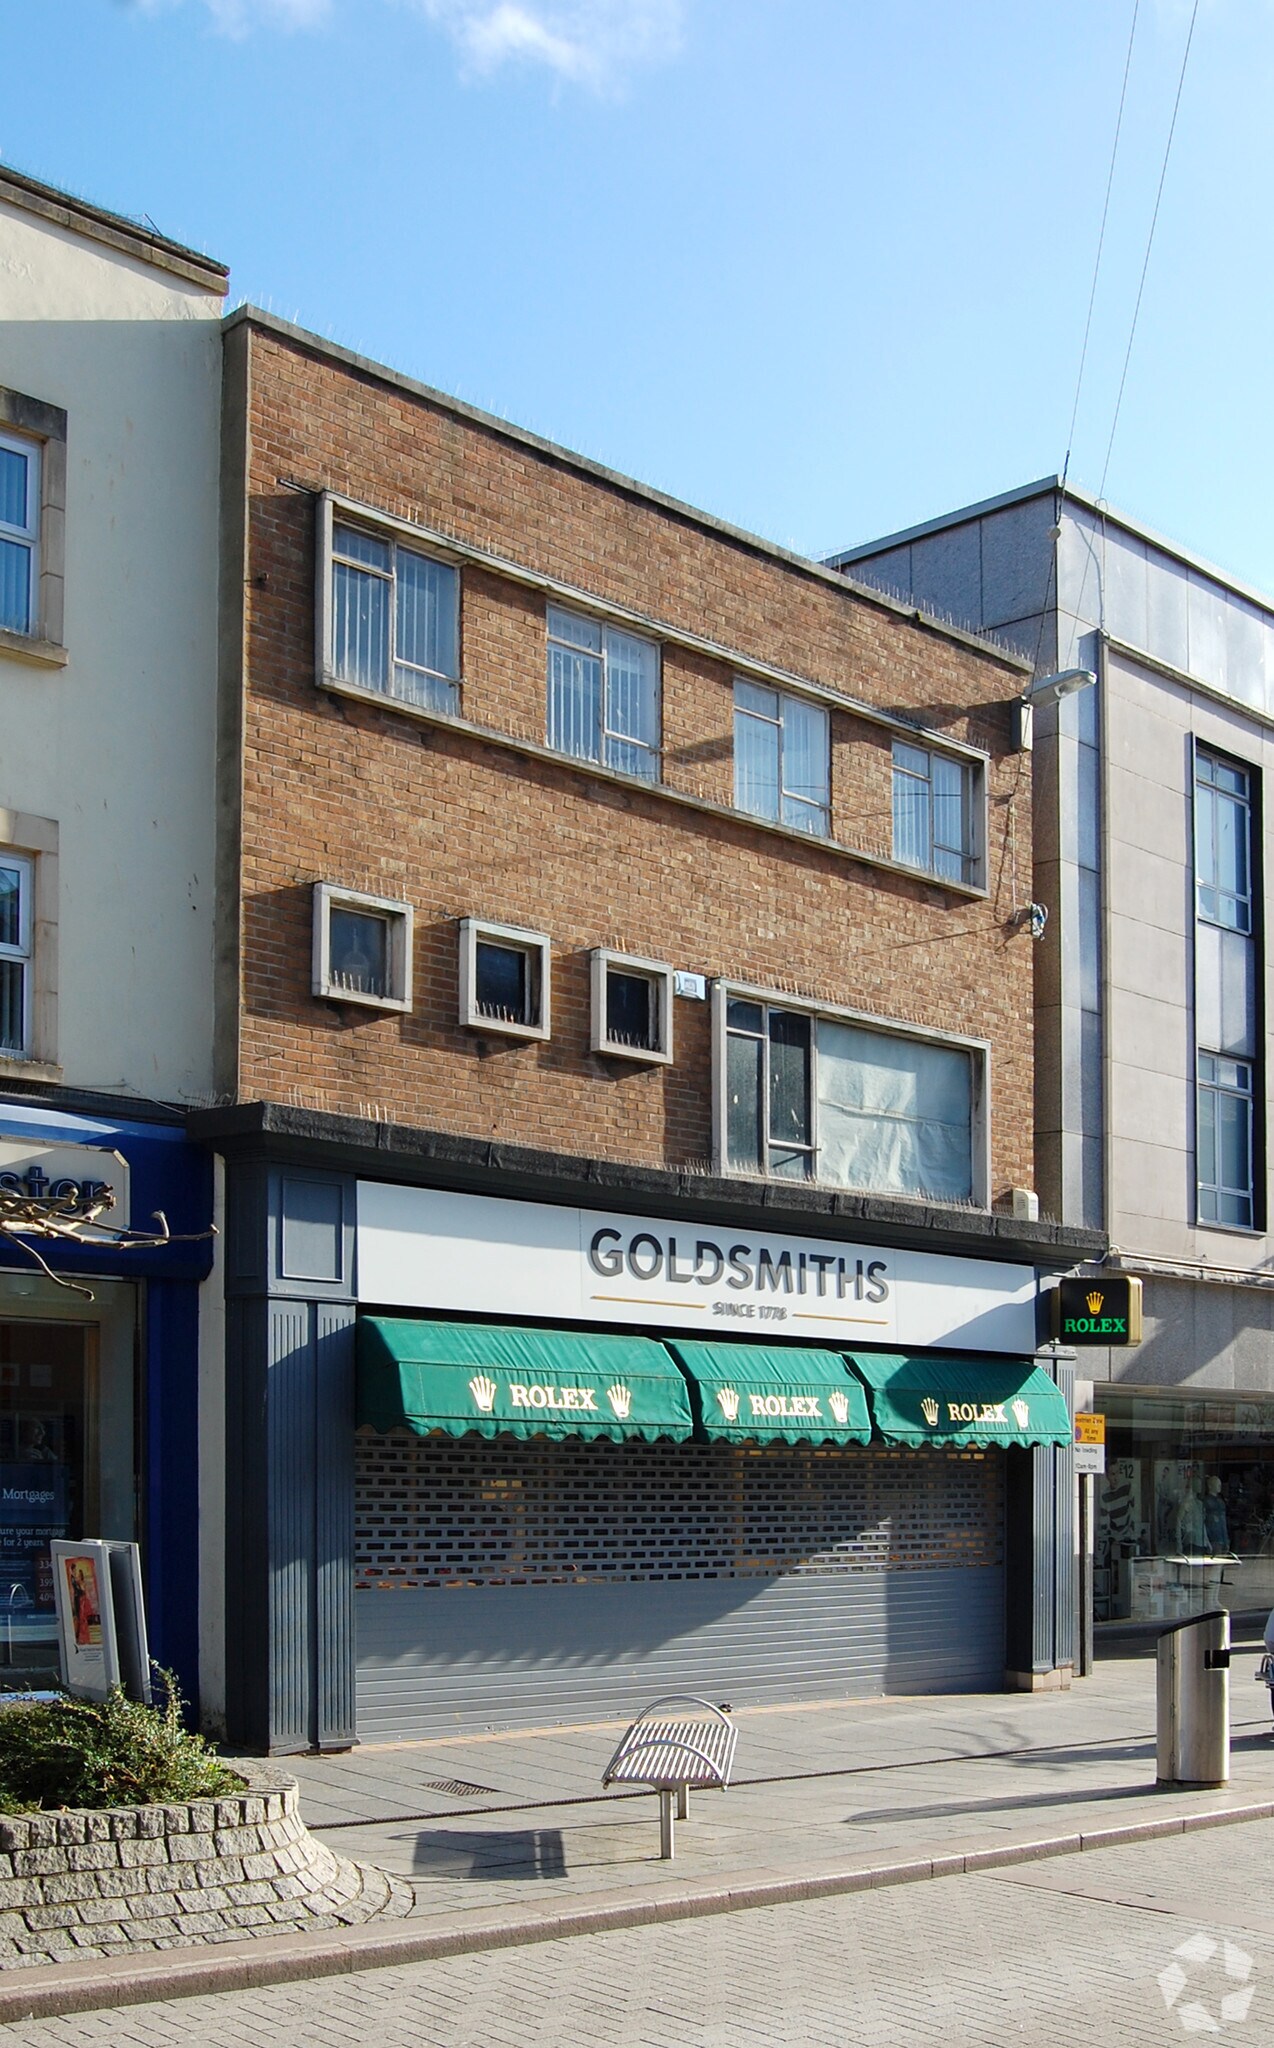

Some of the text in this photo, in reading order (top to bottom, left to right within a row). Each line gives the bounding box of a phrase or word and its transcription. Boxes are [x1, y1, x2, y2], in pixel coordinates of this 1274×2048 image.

[589, 1228, 889, 1304] GOLDSMITHS
[712, 1301, 787, 1321] SINCE 1778
[1064, 1318, 1126, 1333] ROLEX
[509, 1384, 599, 1410] ROLEX
[749, 1395, 823, 1417] ROLEX
[947, 1403, 1009, 1423] ROLEX
[1119, 1464, 1134, 1479] £12
[2, 1488, 55, 1503] Mortgages
[3, 1536, 15, 1547] for
[16, 1538, 22, 1547] 2
[15, 1528, 33, 1538] your
[35, 1528, 66, 1538] mortgage
